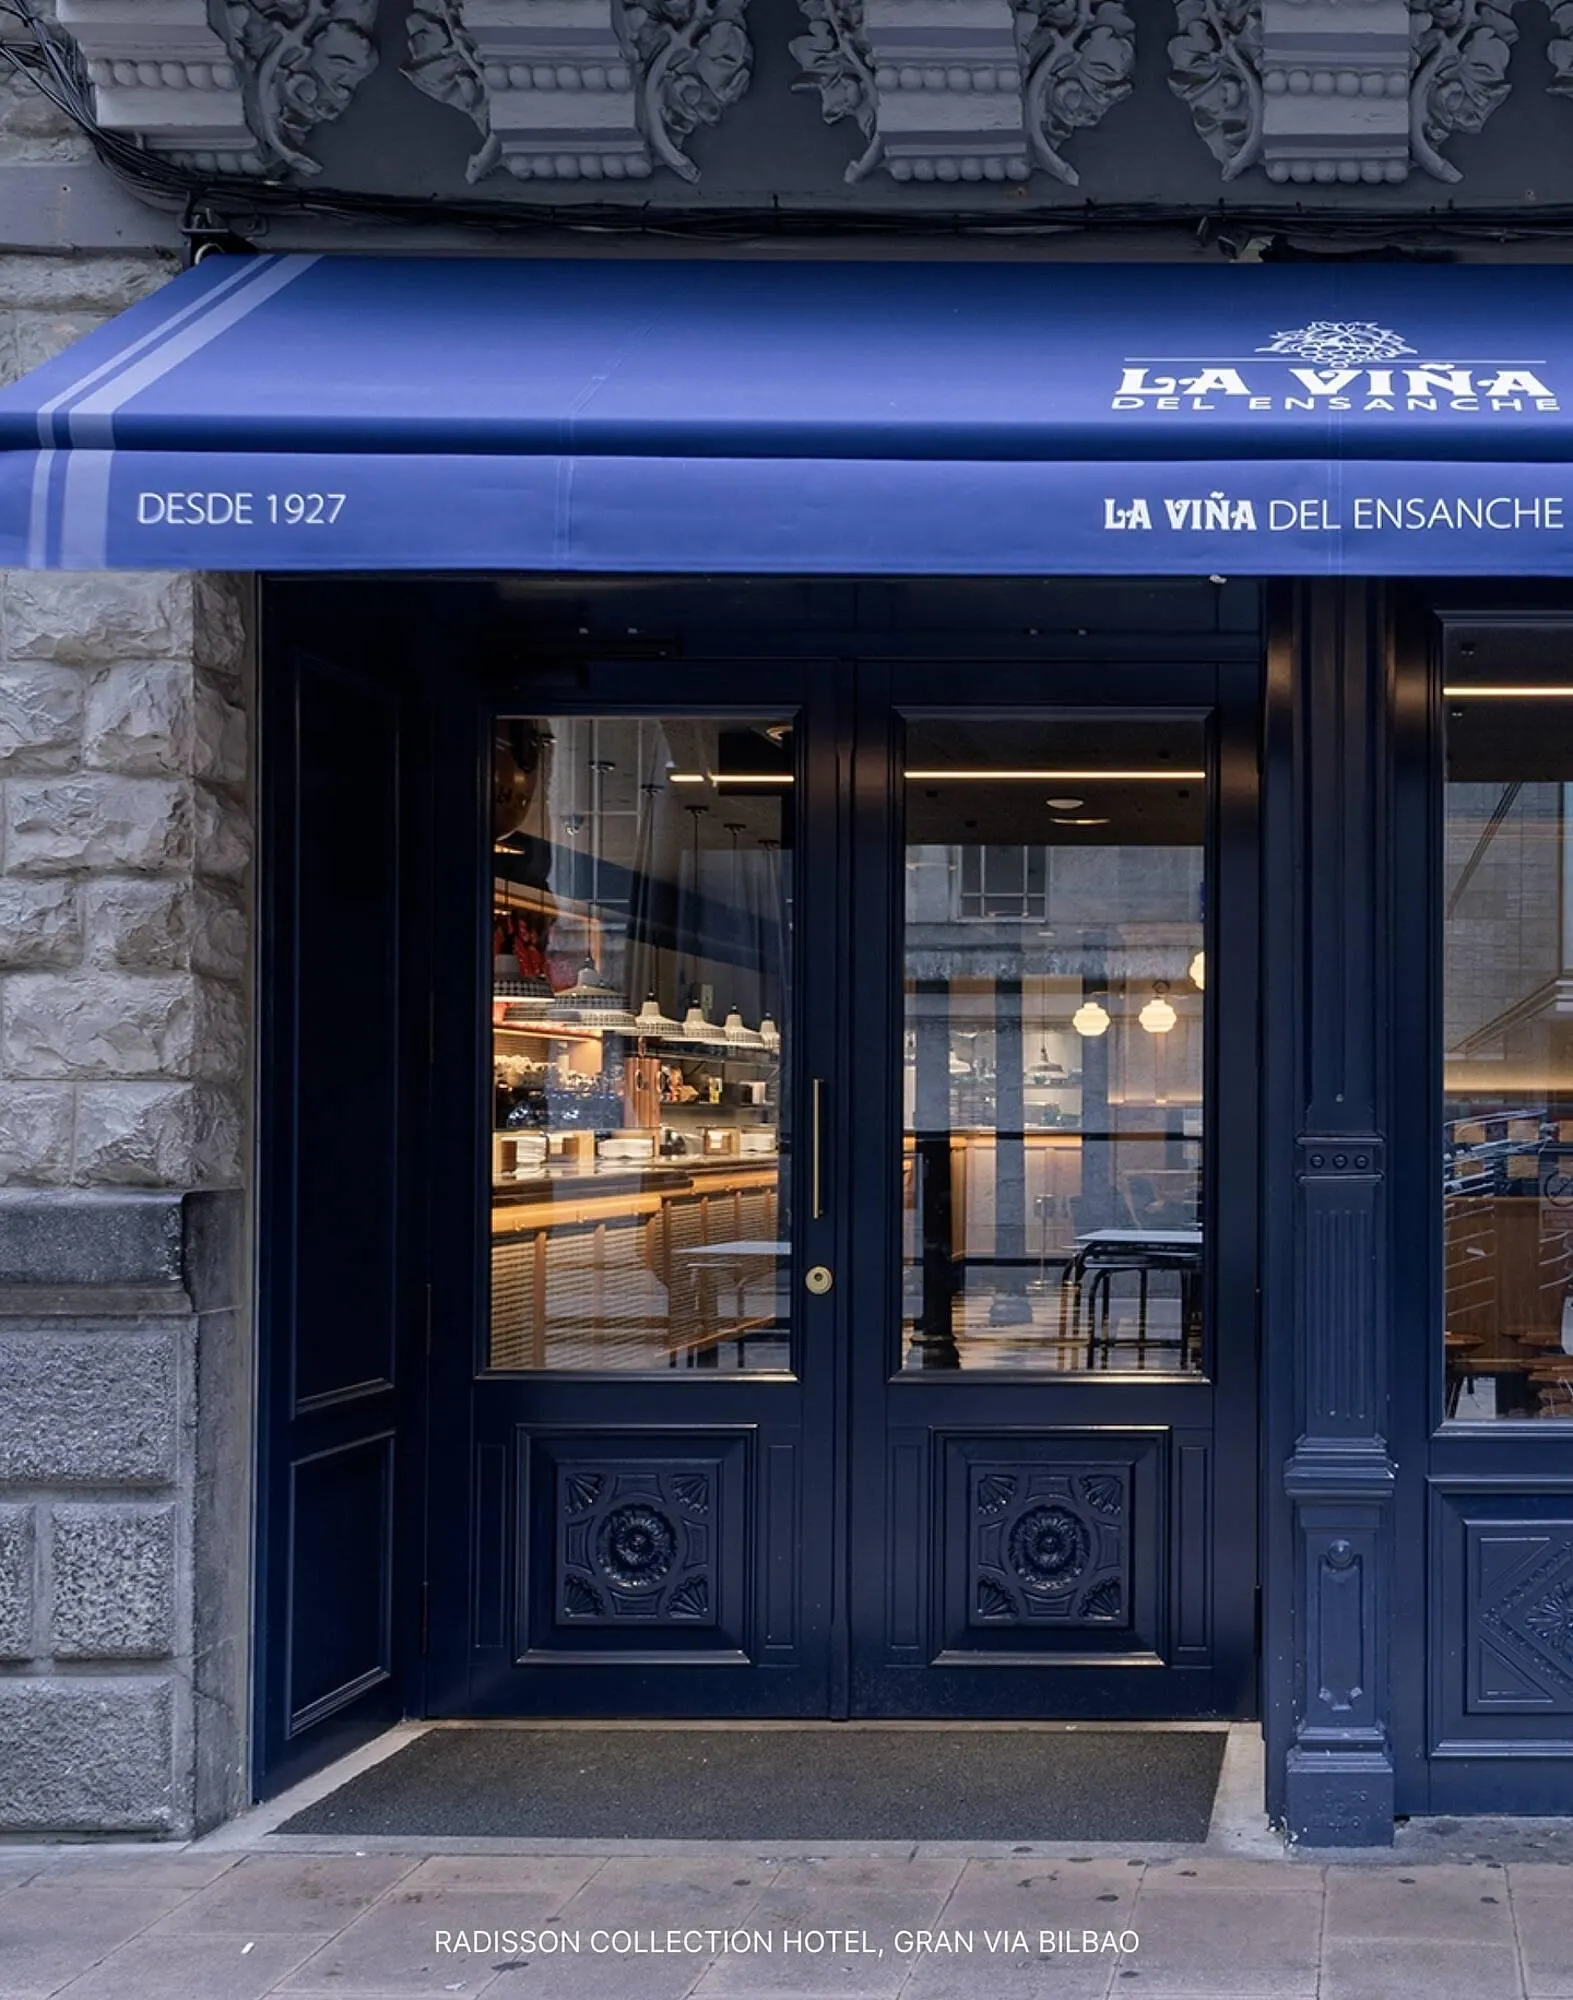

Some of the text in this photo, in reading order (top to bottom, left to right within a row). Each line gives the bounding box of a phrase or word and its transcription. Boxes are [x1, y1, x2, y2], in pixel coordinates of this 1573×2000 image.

[1115, 363, 1554, 397] LA VIÑA
[1111, 397, 1561, 412] DEL ENSANCHE
[137, 492, 347, 525] DESDE 1927
[1104, 491, 1564, 531] LA VIÑA DEL ENSANCHE
